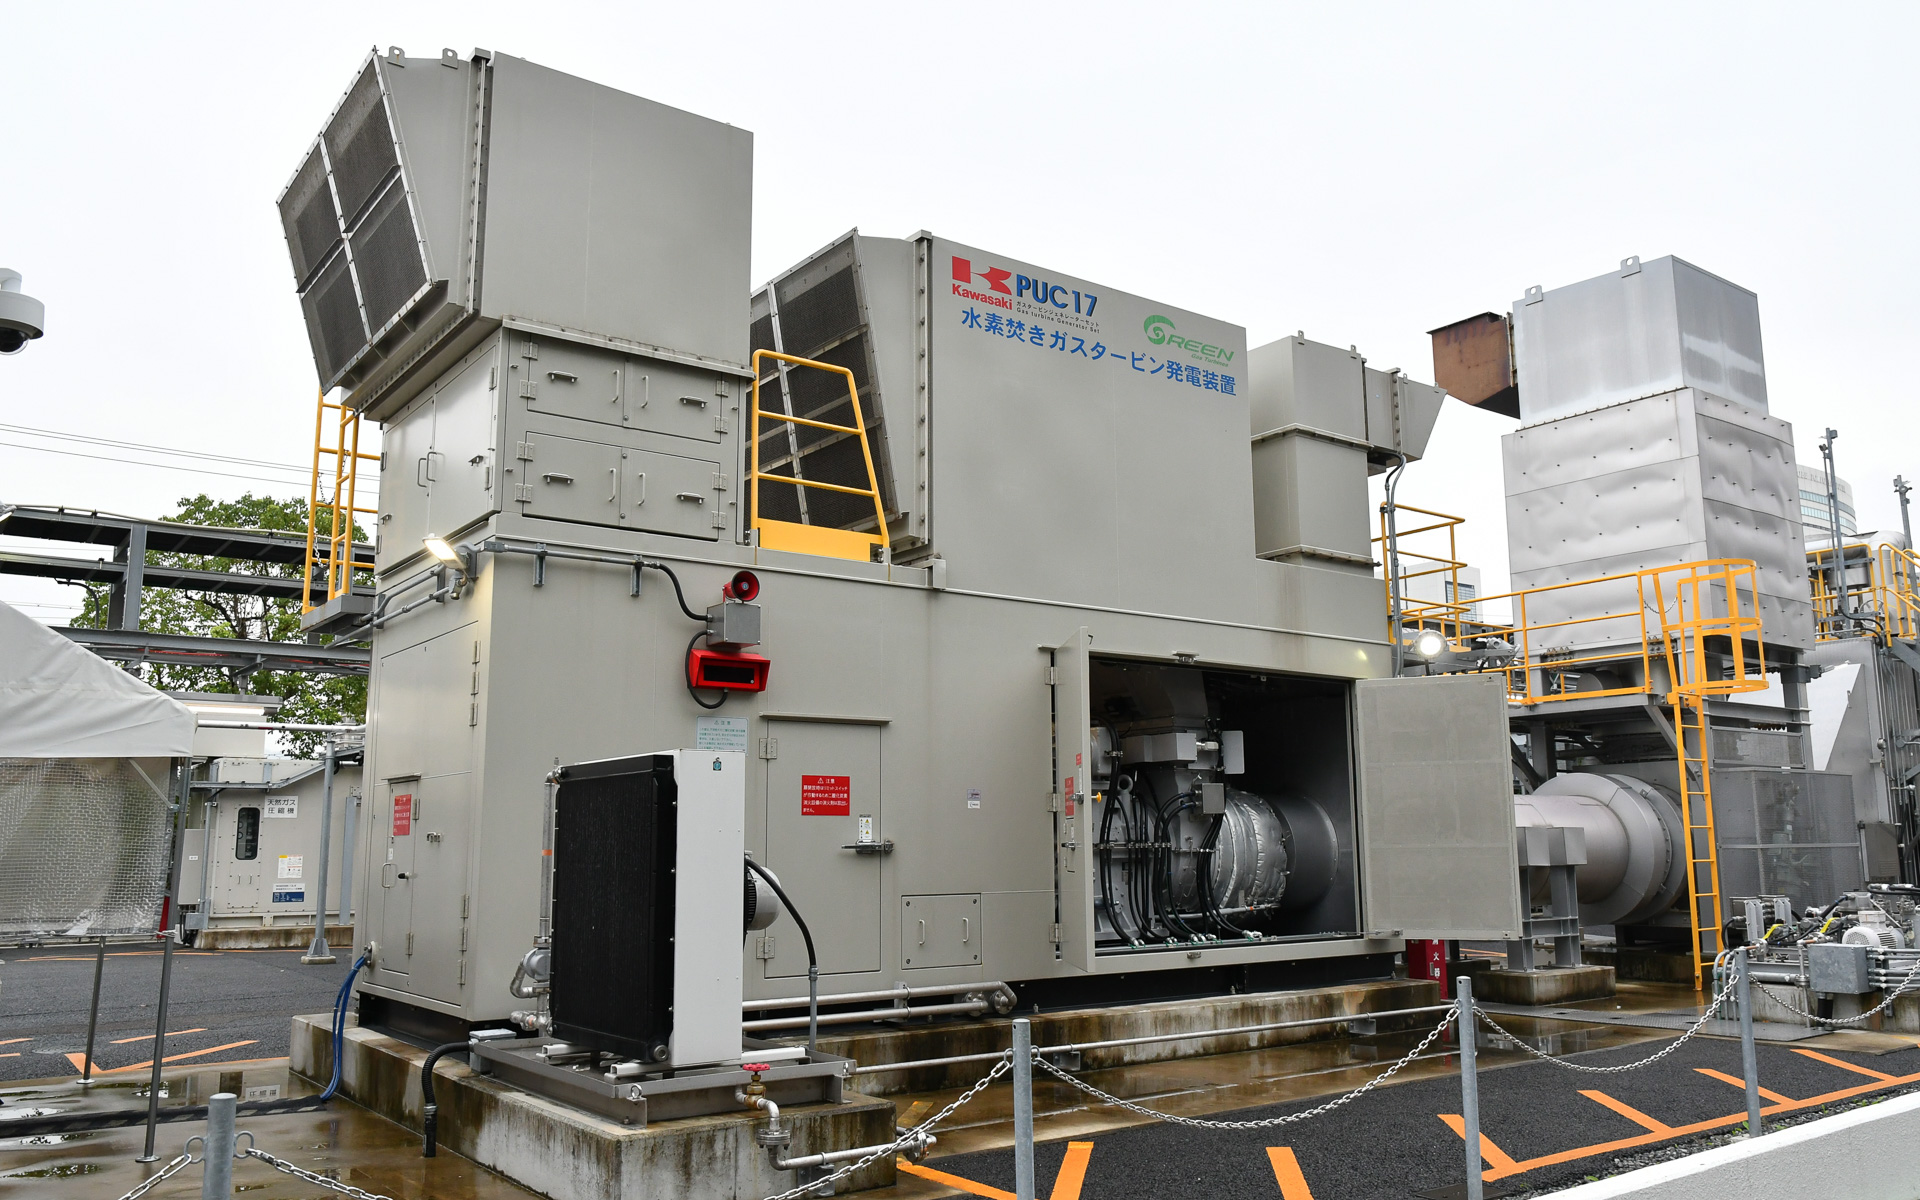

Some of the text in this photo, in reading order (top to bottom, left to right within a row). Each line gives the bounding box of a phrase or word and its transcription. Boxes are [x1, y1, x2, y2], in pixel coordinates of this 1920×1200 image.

[952, 283, 1013, 310] Kawasaki
[1016, 301, 1099, 328] ガスタービンジェネレーターセット
[1016, 307, 1029, 315] Gas
[1031, 311, 1054, 322] turbine
[1057, 318, 1088, 331] Generator
[961, 306, 1237, 397] 水素焚きガスタービン発電装置
[1191, 353, 1229, 368] Gas Turbines
[267, 798, 296, 806] 天然ガス
[267, 807, 295, 815] 圧縮機
